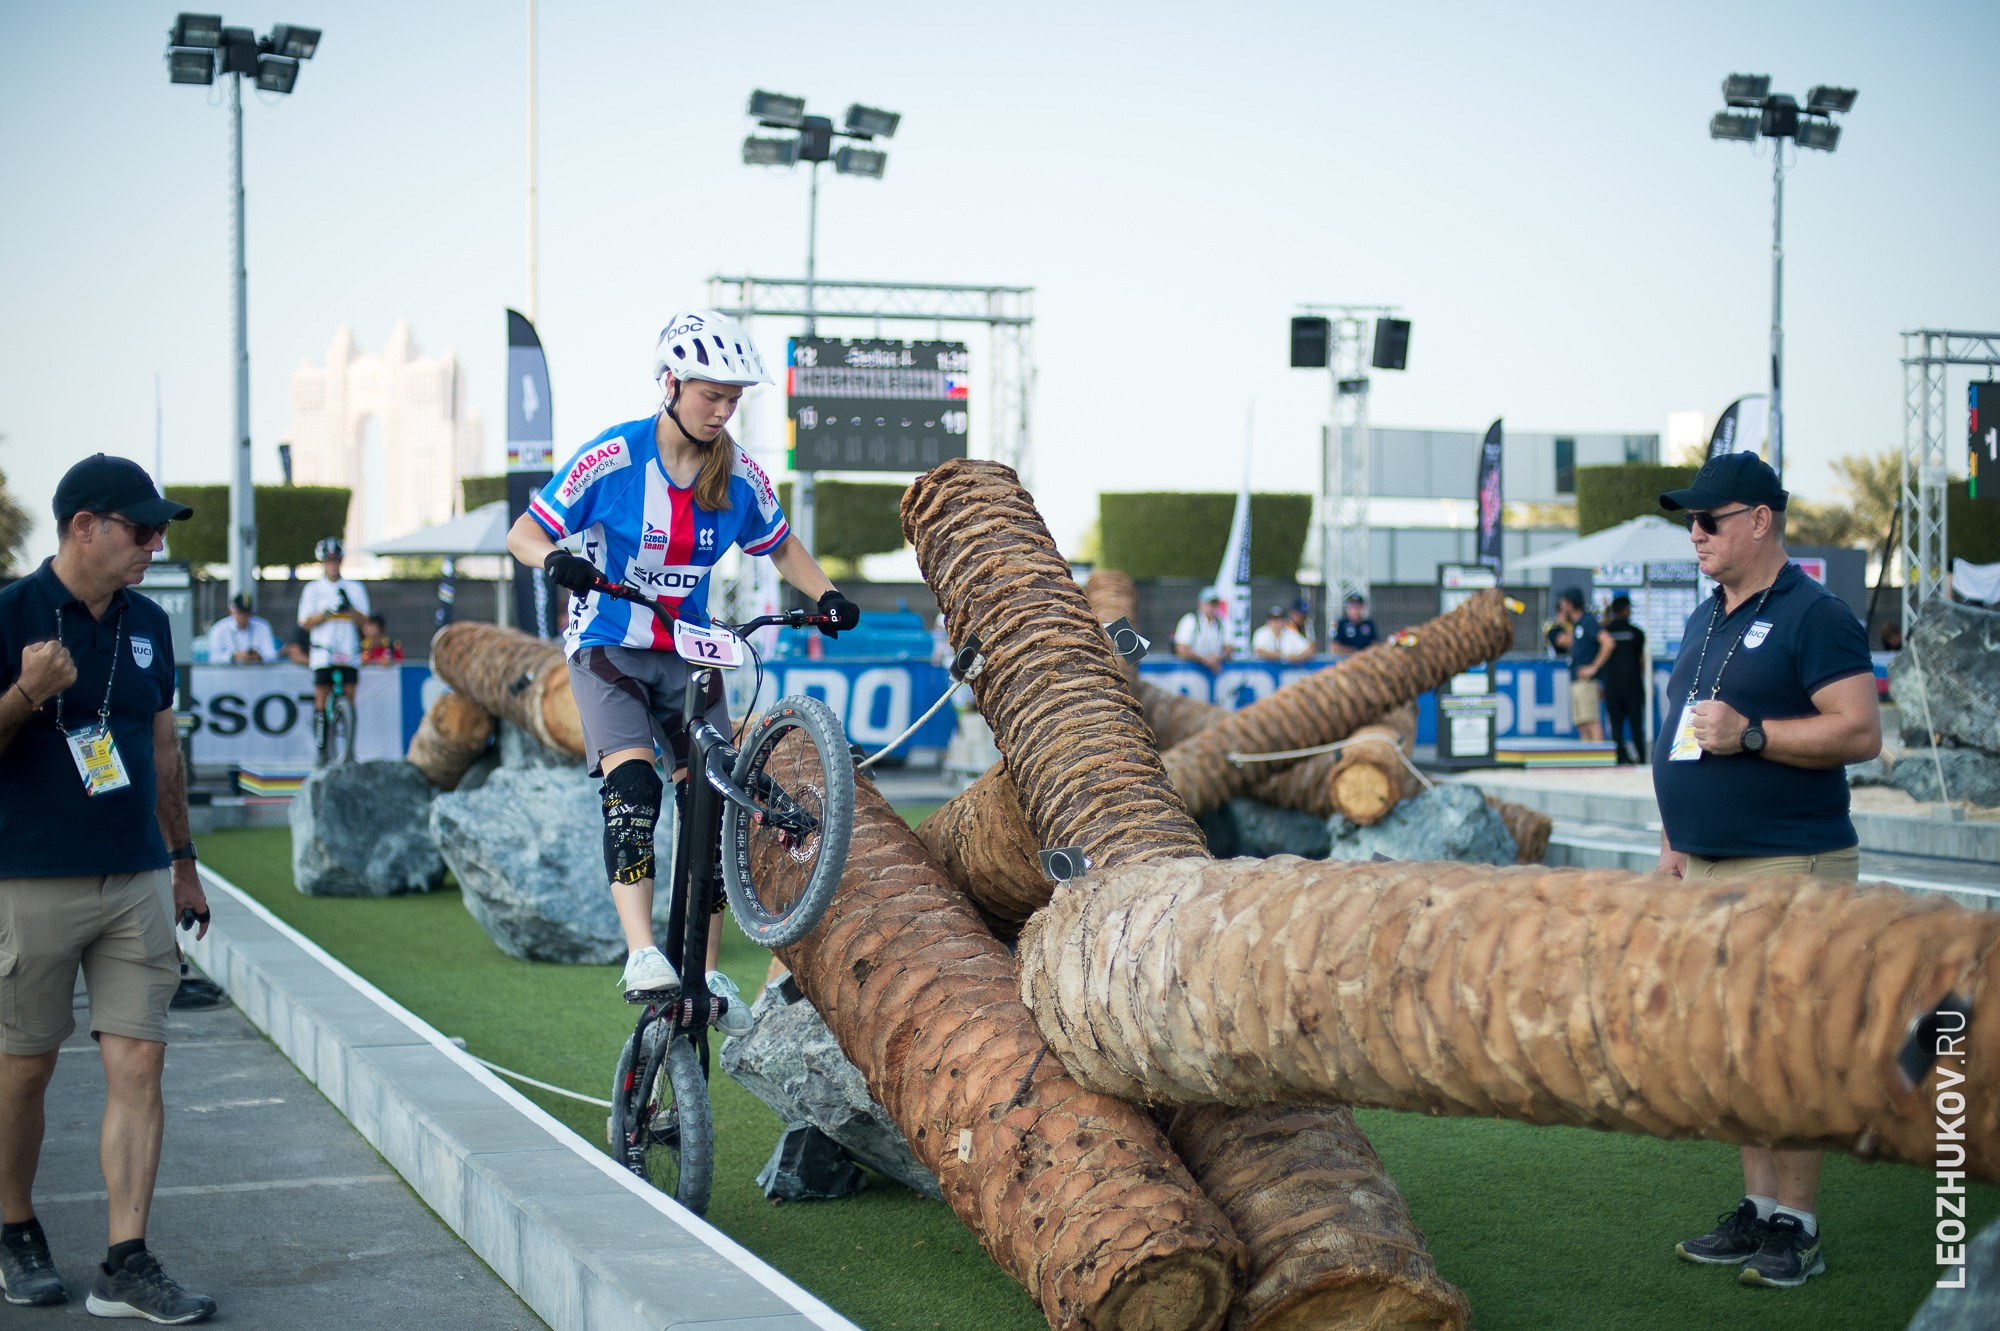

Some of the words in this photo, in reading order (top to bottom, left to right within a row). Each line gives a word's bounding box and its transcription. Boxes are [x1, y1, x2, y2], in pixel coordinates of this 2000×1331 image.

[563, 443, 620, 497] STRABAG
[570, 474, 592, 496] TEAMS
[591, 458, 618, 475] WORK.
[643, 534, 668, 544] czech
[644, 542, 665, 551] team
[694, 640, 721, 659] 12
